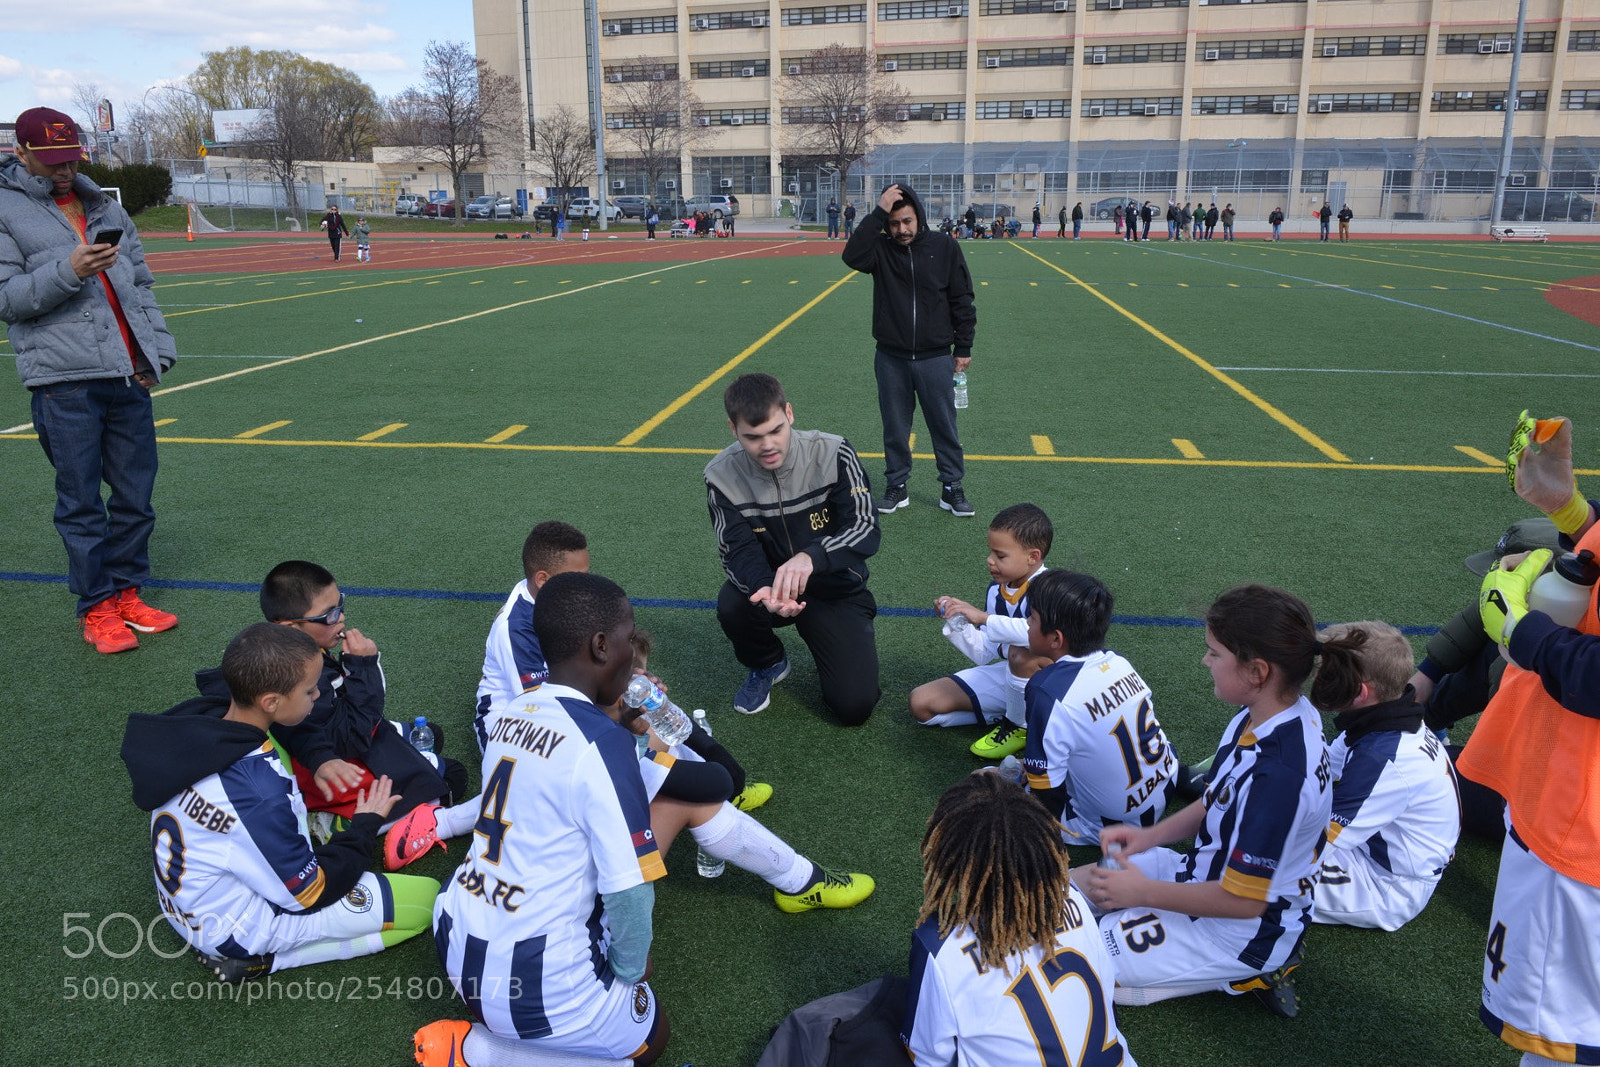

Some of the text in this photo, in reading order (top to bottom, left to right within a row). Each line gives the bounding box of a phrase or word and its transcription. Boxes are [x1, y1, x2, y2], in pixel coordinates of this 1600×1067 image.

[487, 717, 566, 760] OTCHWAY
[1109, 697, 1168, 790] 16
[177, 786, 238, 835] TIBEBE
[473, 755, 518, 867] 4
[1125, 769, 1167, 815] ALBA
[491, 877, 526, 913] FC
[1120, 912, 1166, 954] 13
[1486, 920, 1507, 984] 4
[1004, 947, 1124, 1067] 12
